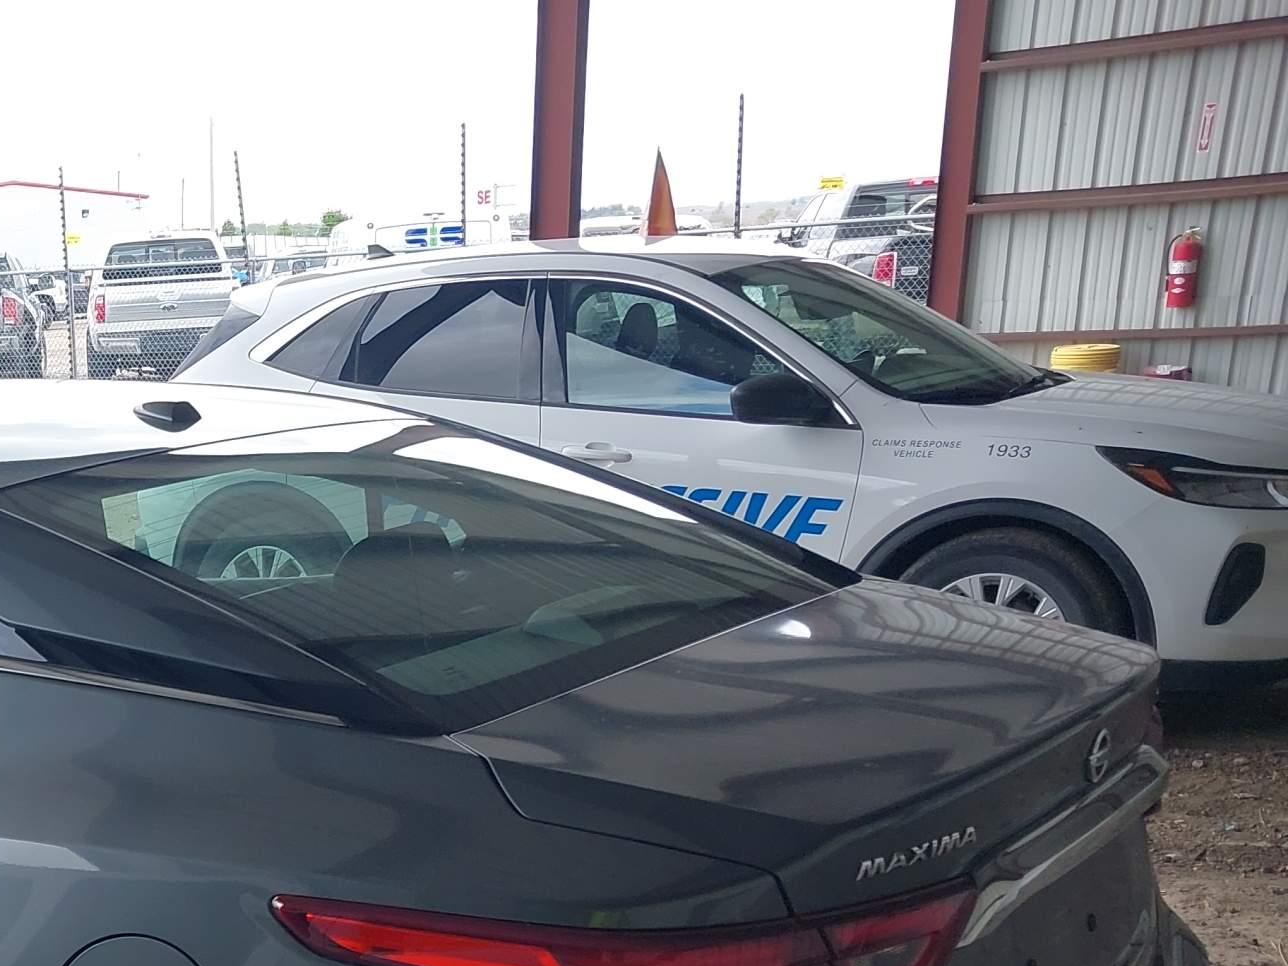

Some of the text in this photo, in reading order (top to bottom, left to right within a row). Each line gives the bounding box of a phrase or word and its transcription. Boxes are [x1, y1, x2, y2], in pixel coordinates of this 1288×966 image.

[871, 438, 962, 449] CLAIMS RESPONSE
[893, 449, 935, 459] VEHICLE
[987, 444, 1032, 459] 1933
[856, 825, 978, 881] MAXIMA
